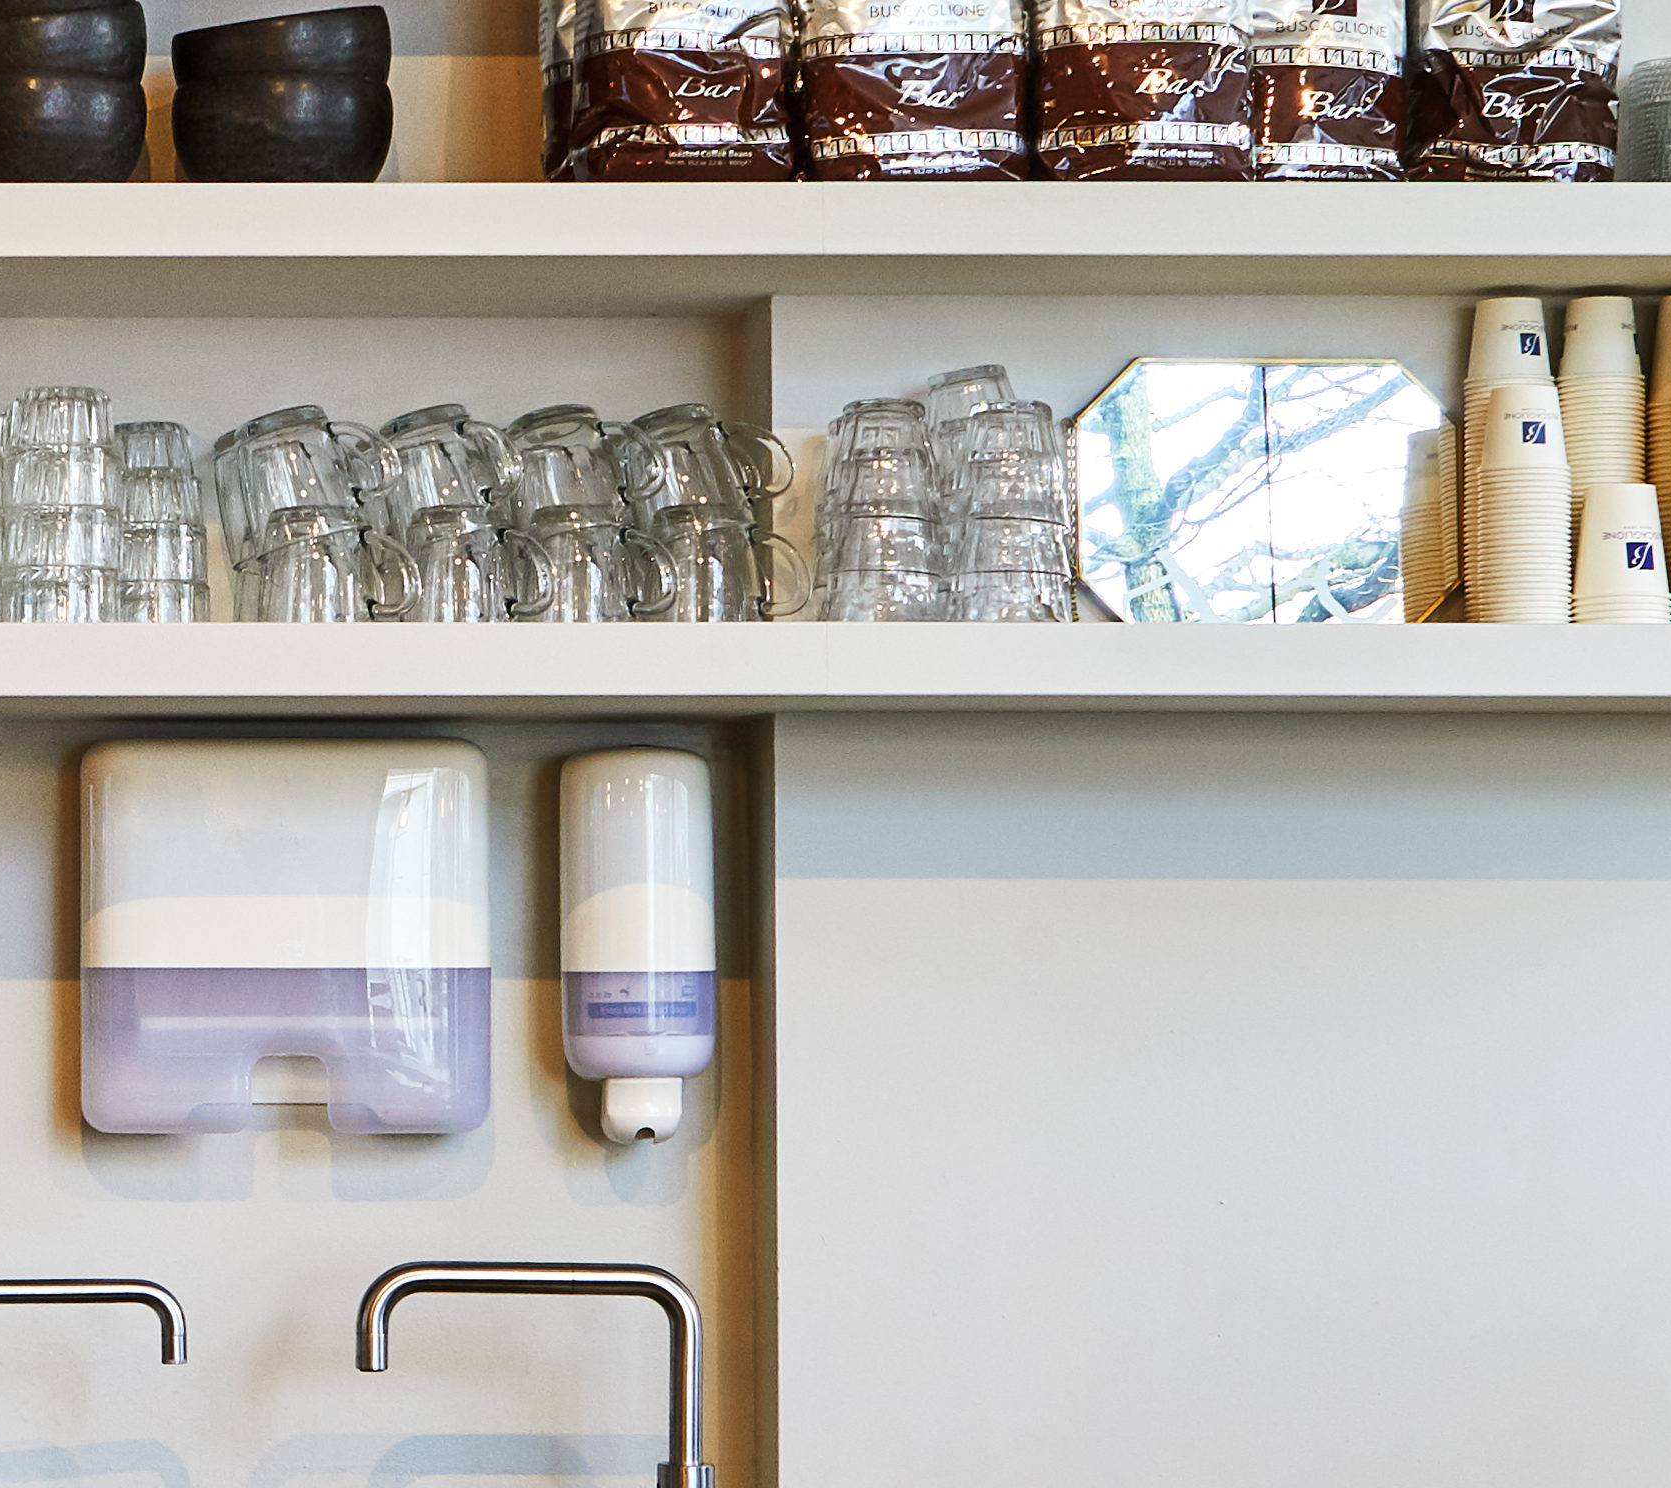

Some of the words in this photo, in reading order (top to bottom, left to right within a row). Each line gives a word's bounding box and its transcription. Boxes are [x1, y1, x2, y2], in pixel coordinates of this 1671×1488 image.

[675, 76, 742, 99] Bar
[899, 79, 964, 109] Bar
[1135, 68, 1203, 96] Bar
[1298, 90, 1362, 120] Bar
[1483, 92, 1546, 119] Bar
